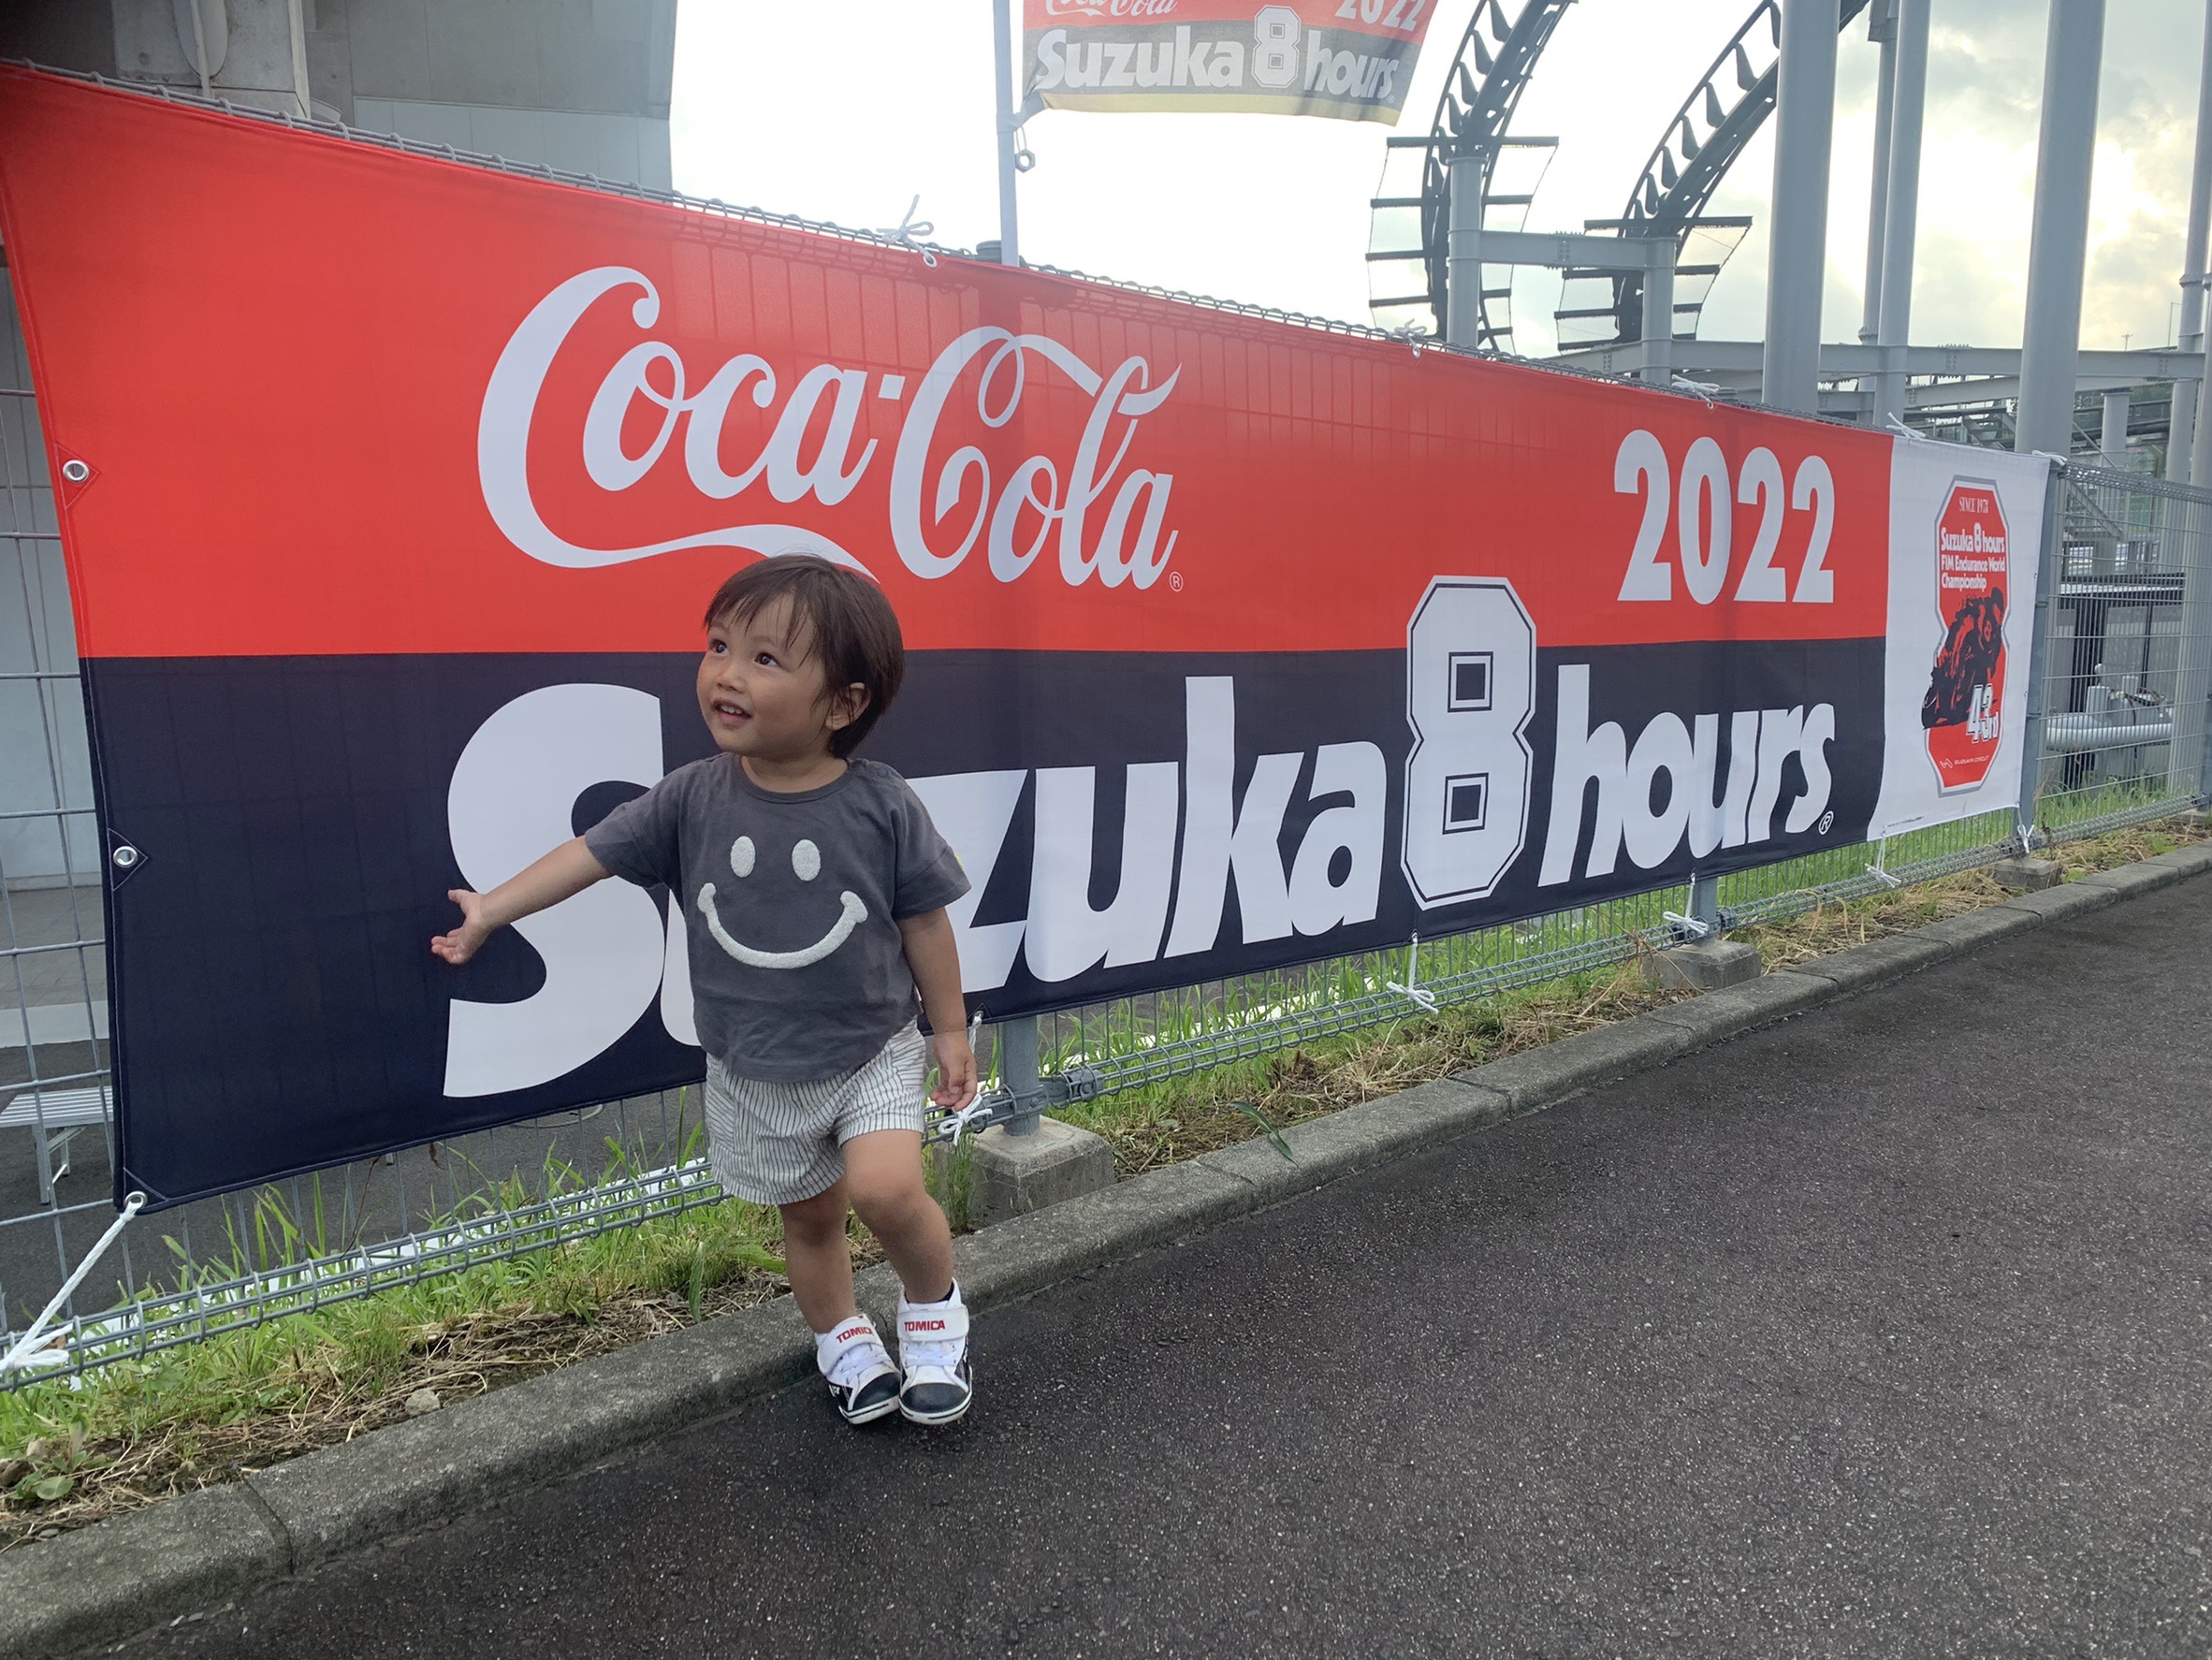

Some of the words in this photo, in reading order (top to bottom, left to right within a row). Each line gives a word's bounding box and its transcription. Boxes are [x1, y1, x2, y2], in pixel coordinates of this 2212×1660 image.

[1036, 25, 1245, 90] Suzuka
[1252, 5, 1302, 90] 8
[1305, 30, 1399, 100] hours
[477, 266, 1182, 588] Coca-Cola
[1614, 429, 1836, 605] 2022
[1941, 527, 1973, 553] Suzuka
[1973, 522, 1982, 553] 8
[1982, 530, 2005, 553] hours
[1941, 554, 1955, 571] FIM
[1955, 555, 1987, 573] Endurance
[1988, 556, 2005, 573] World
[1942, 574, 1986, 591] Championship
[444, 676, 1388, 1099] Szuka
[1400, 575, 1536, 911] 8
[1537, 663, 1836, 888] hours
[904, 1319, 945, 1332] TOMICA
